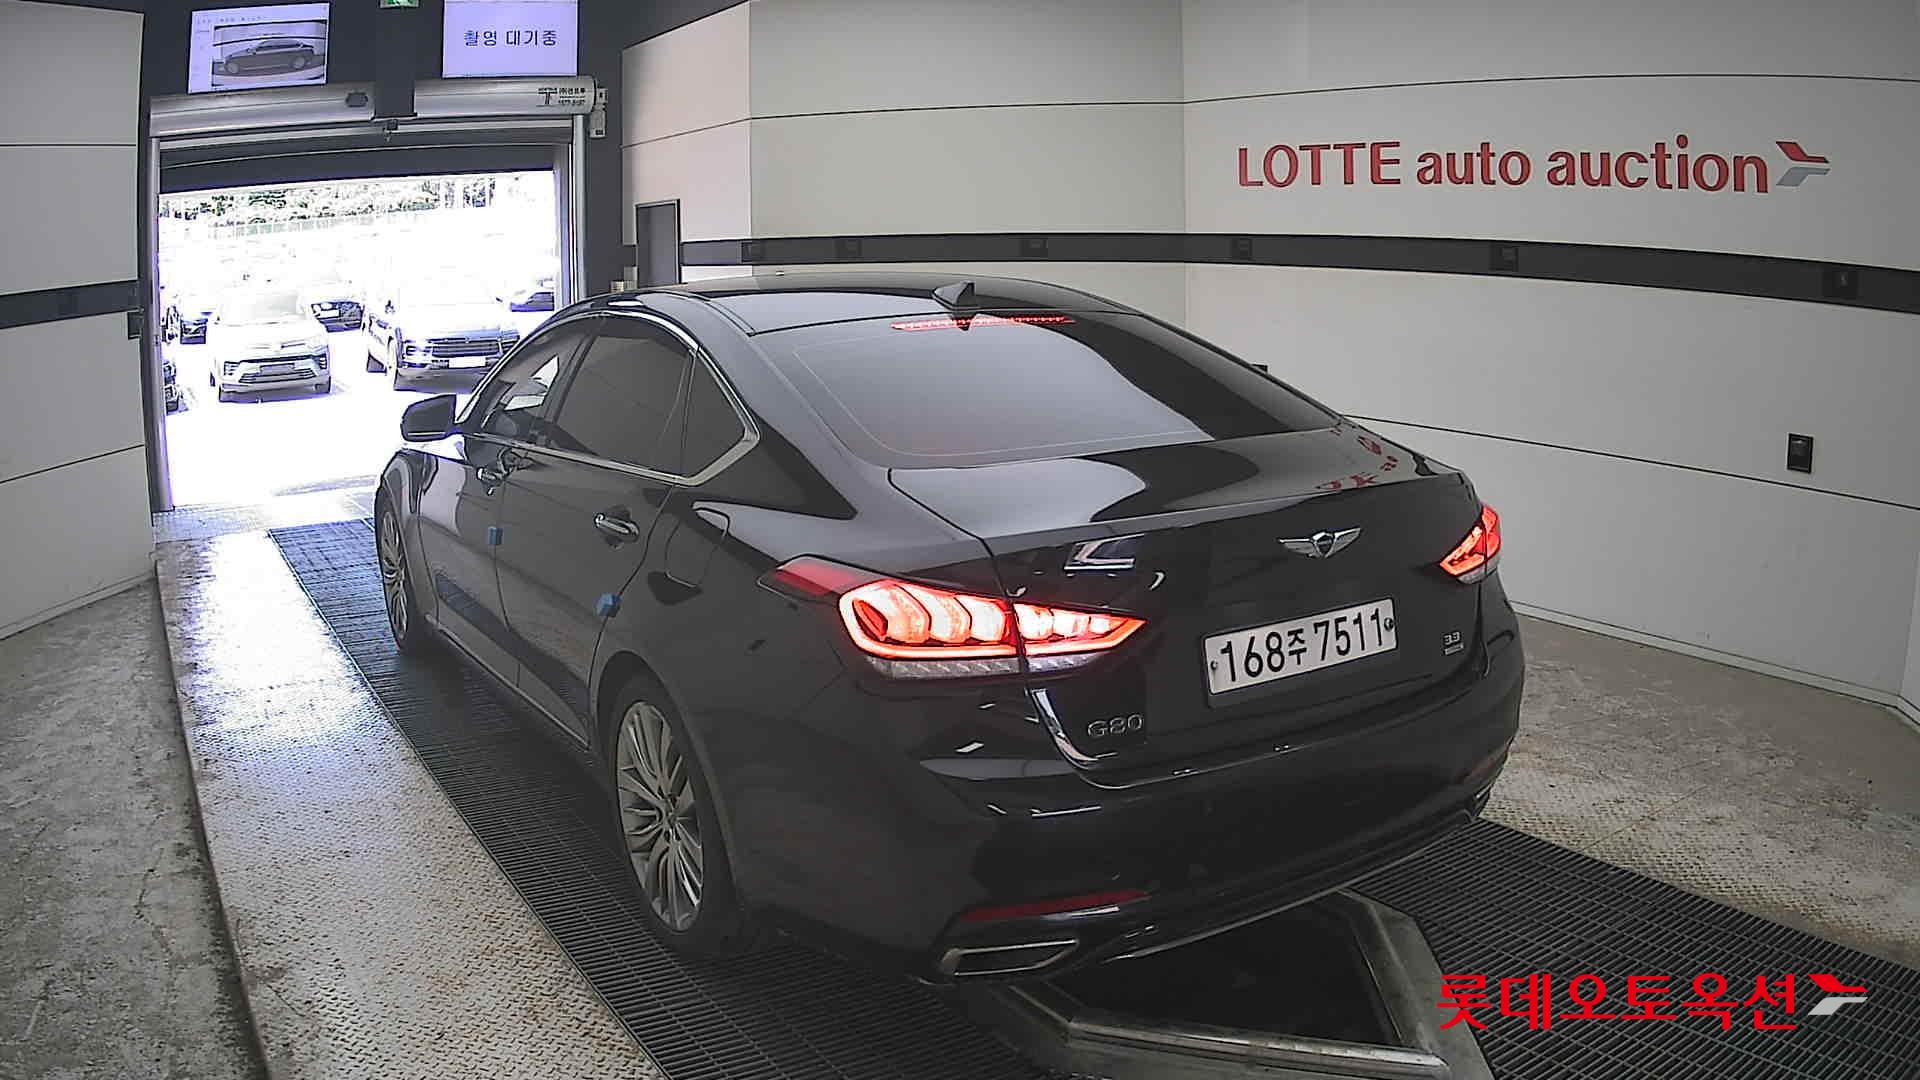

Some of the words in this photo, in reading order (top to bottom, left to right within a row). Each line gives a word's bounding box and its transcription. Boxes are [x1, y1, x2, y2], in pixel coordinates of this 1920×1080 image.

[506, 29, 558, 46] 대기중
[1238, 141, 1400, 188] LOTTE
[1417, 142, 1532, 186] auto
[1546, 135, 1769, 194] auction
[1087, 713, 1146, 738] G80
